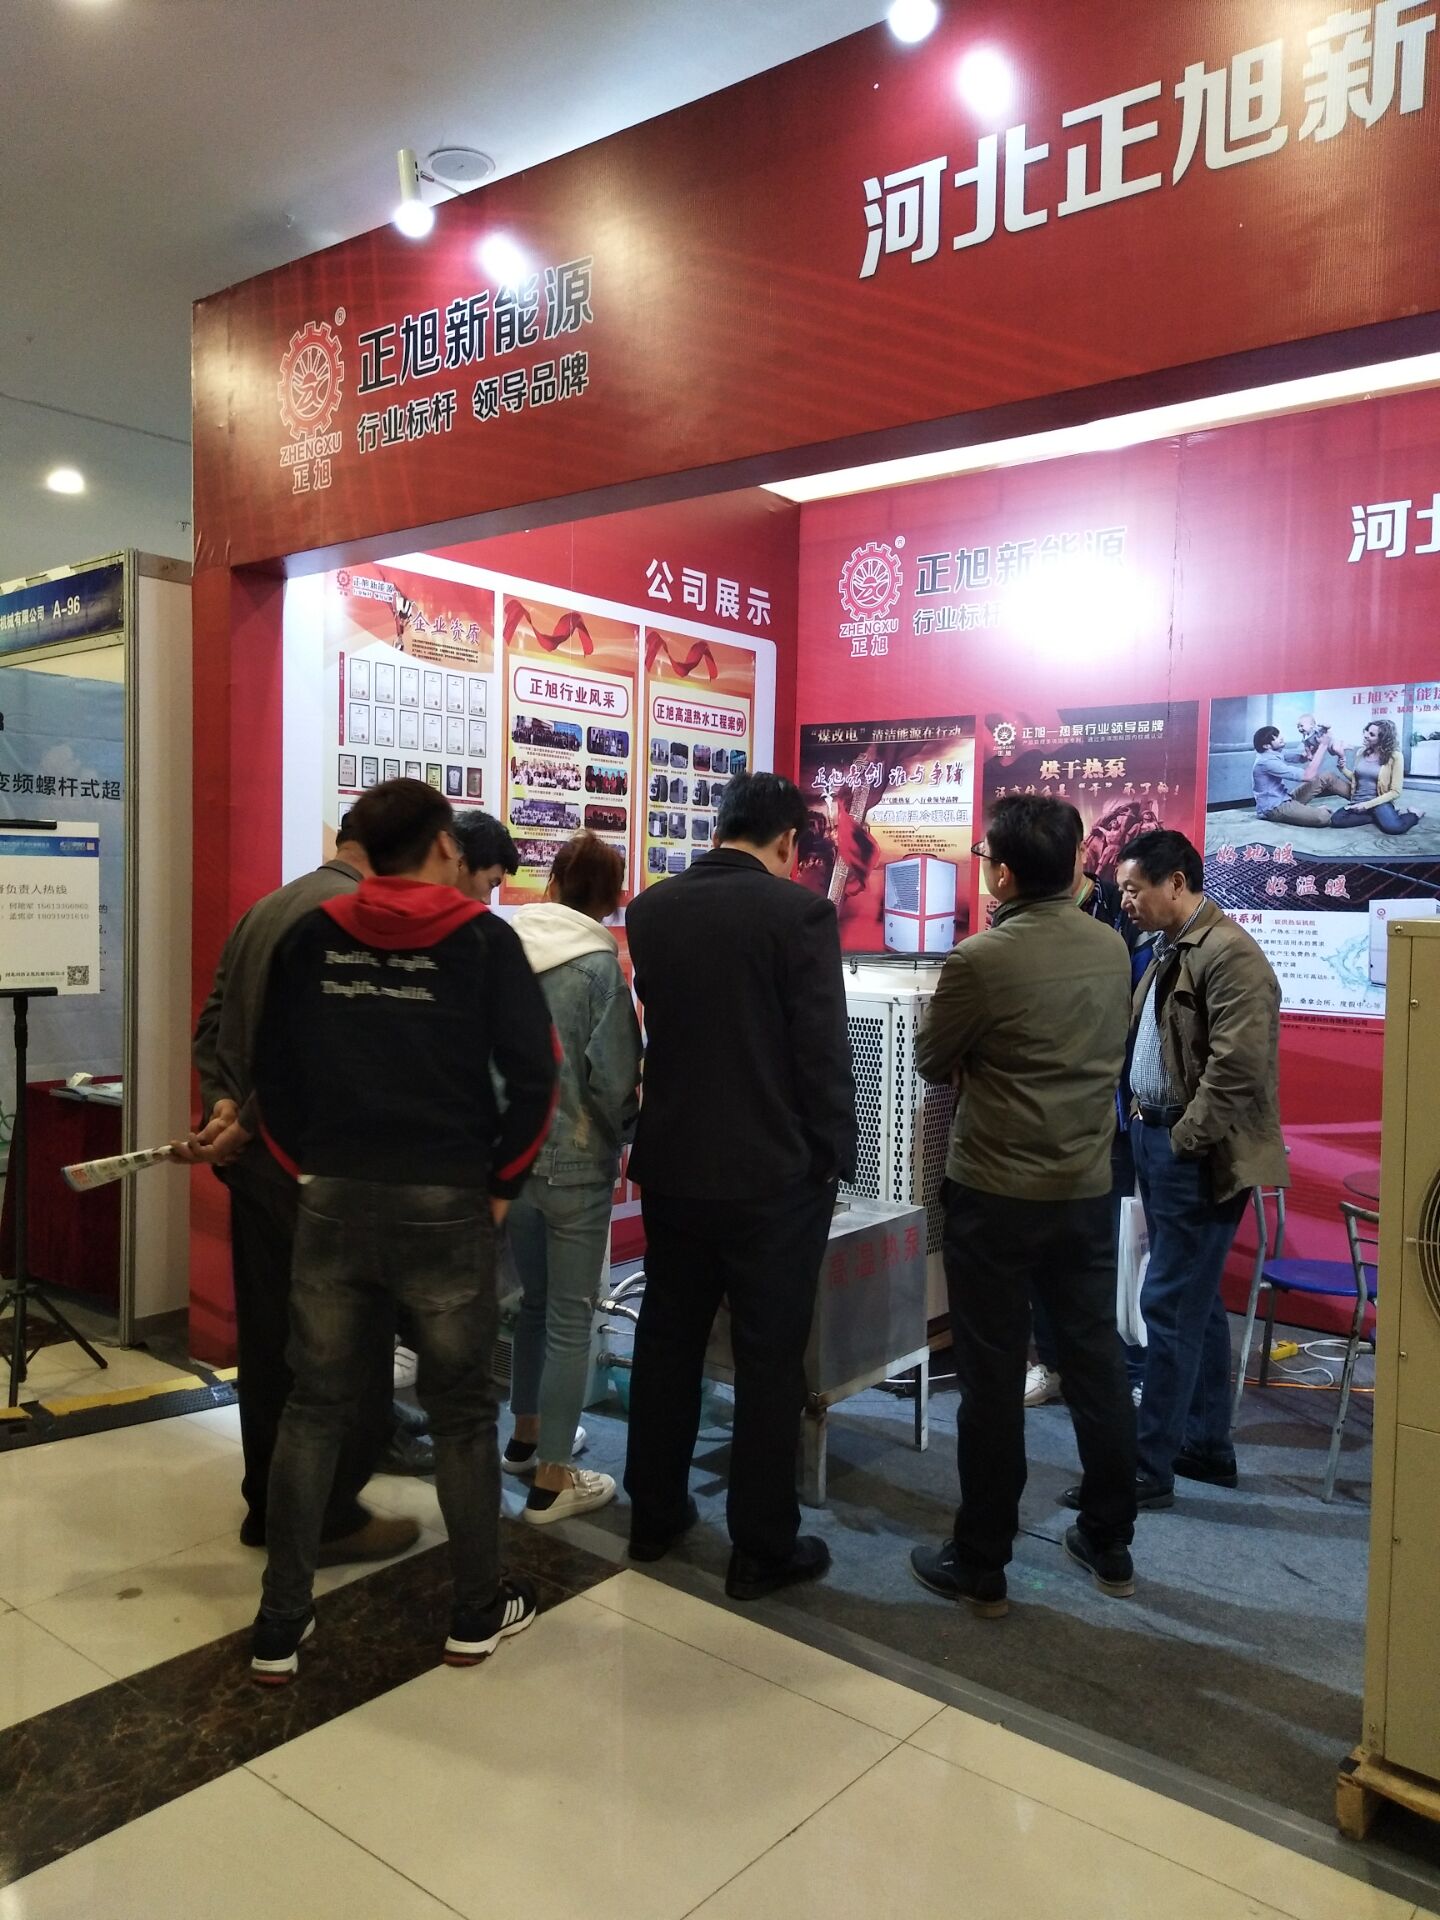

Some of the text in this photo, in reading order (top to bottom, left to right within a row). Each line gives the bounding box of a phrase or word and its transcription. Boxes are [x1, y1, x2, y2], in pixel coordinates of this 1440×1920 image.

[859, 0, 1437, 279] 河北正旭新
[358, 256, 594, 396] 正旭新能源
[357, 351, 589, 453] 行业标杆 领导品牌
[280, 431, 342, 467] ZHENGXU
[292, 459, 332, 494] 正旭
[52, 595, 81, 619] A-96
[645, 558, 771, 626] 公司展示
[412, 611, 481, 646] 企业资质
[840, 619, 899, 637] ZHENGXU
[851, 636, 888, 657] 正旭
[530, 677, 617, 709] 正旭行业风采
[656, 703, 745, 733] 正旭高温热水工程案例
[872, 726, 961, 741] 清洁能源在行动
[1039, 757, 1126, 780] 烘干热泵
[1216, 843, 1298, 866] 好地暖
[1266, 875, 1351, 899] 好温暖
